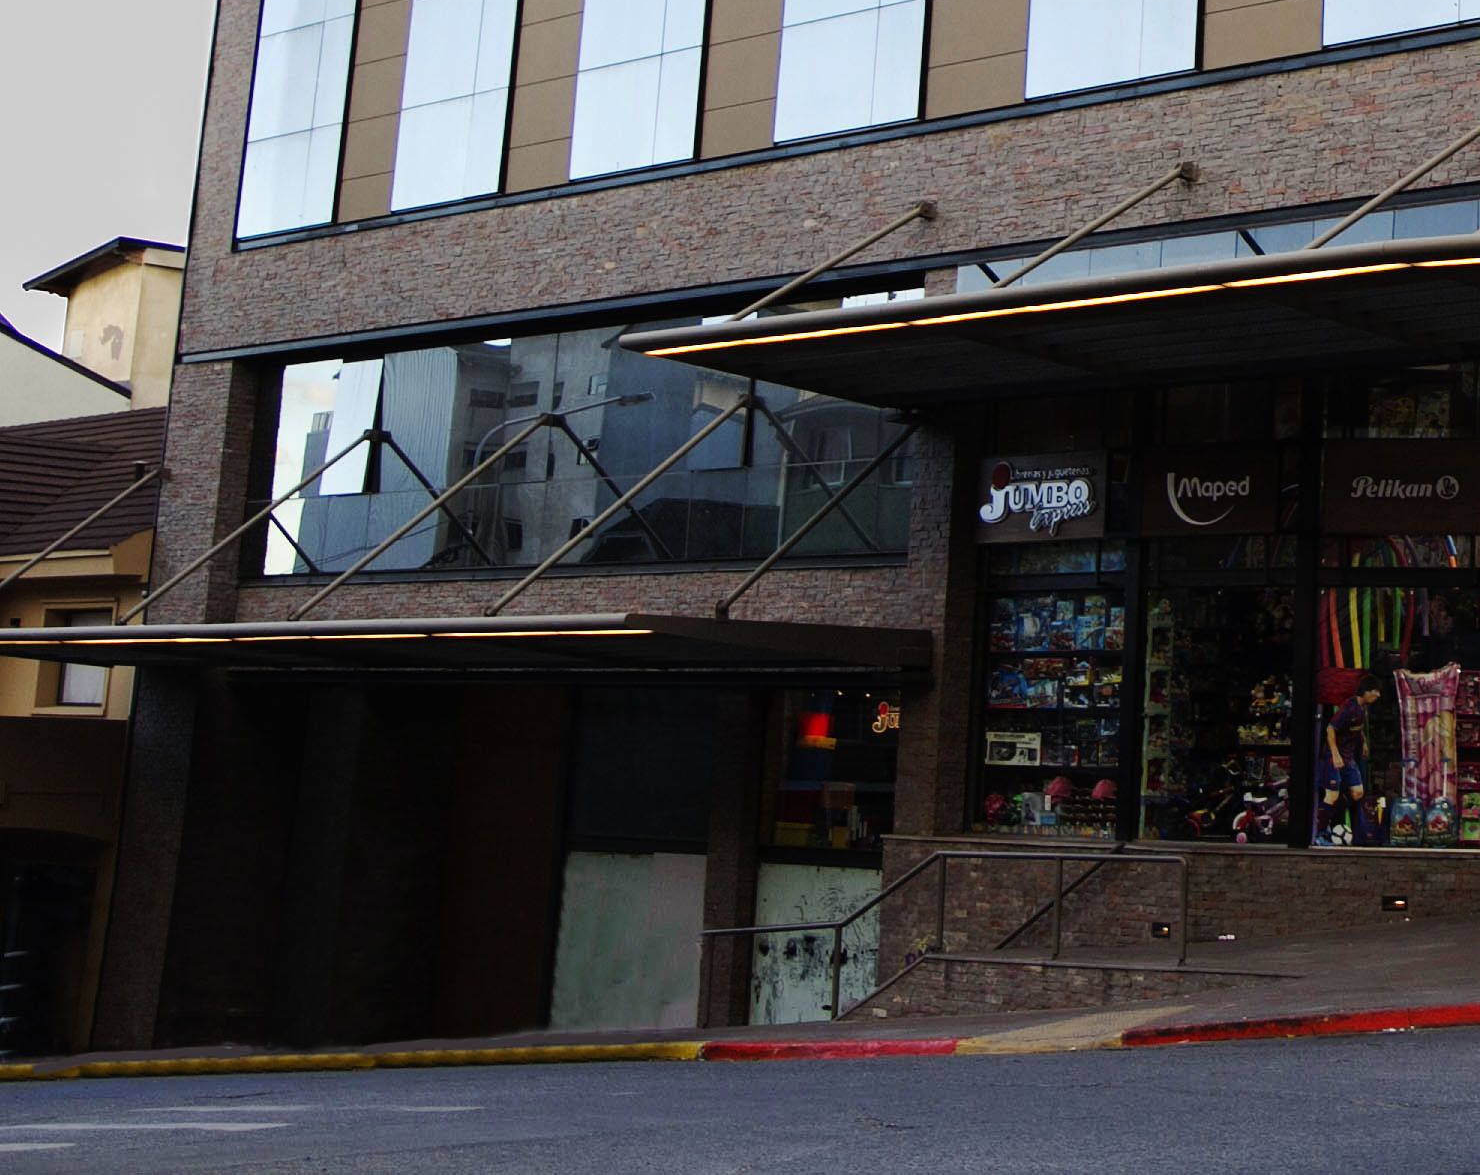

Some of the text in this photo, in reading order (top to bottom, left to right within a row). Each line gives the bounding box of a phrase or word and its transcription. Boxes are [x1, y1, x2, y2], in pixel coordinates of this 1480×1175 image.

[979, 478, 1091, 523] JUMBO
[1177, 475, 1250, 501] Maped
[1350, 476, 1432, 499] Pelikan
